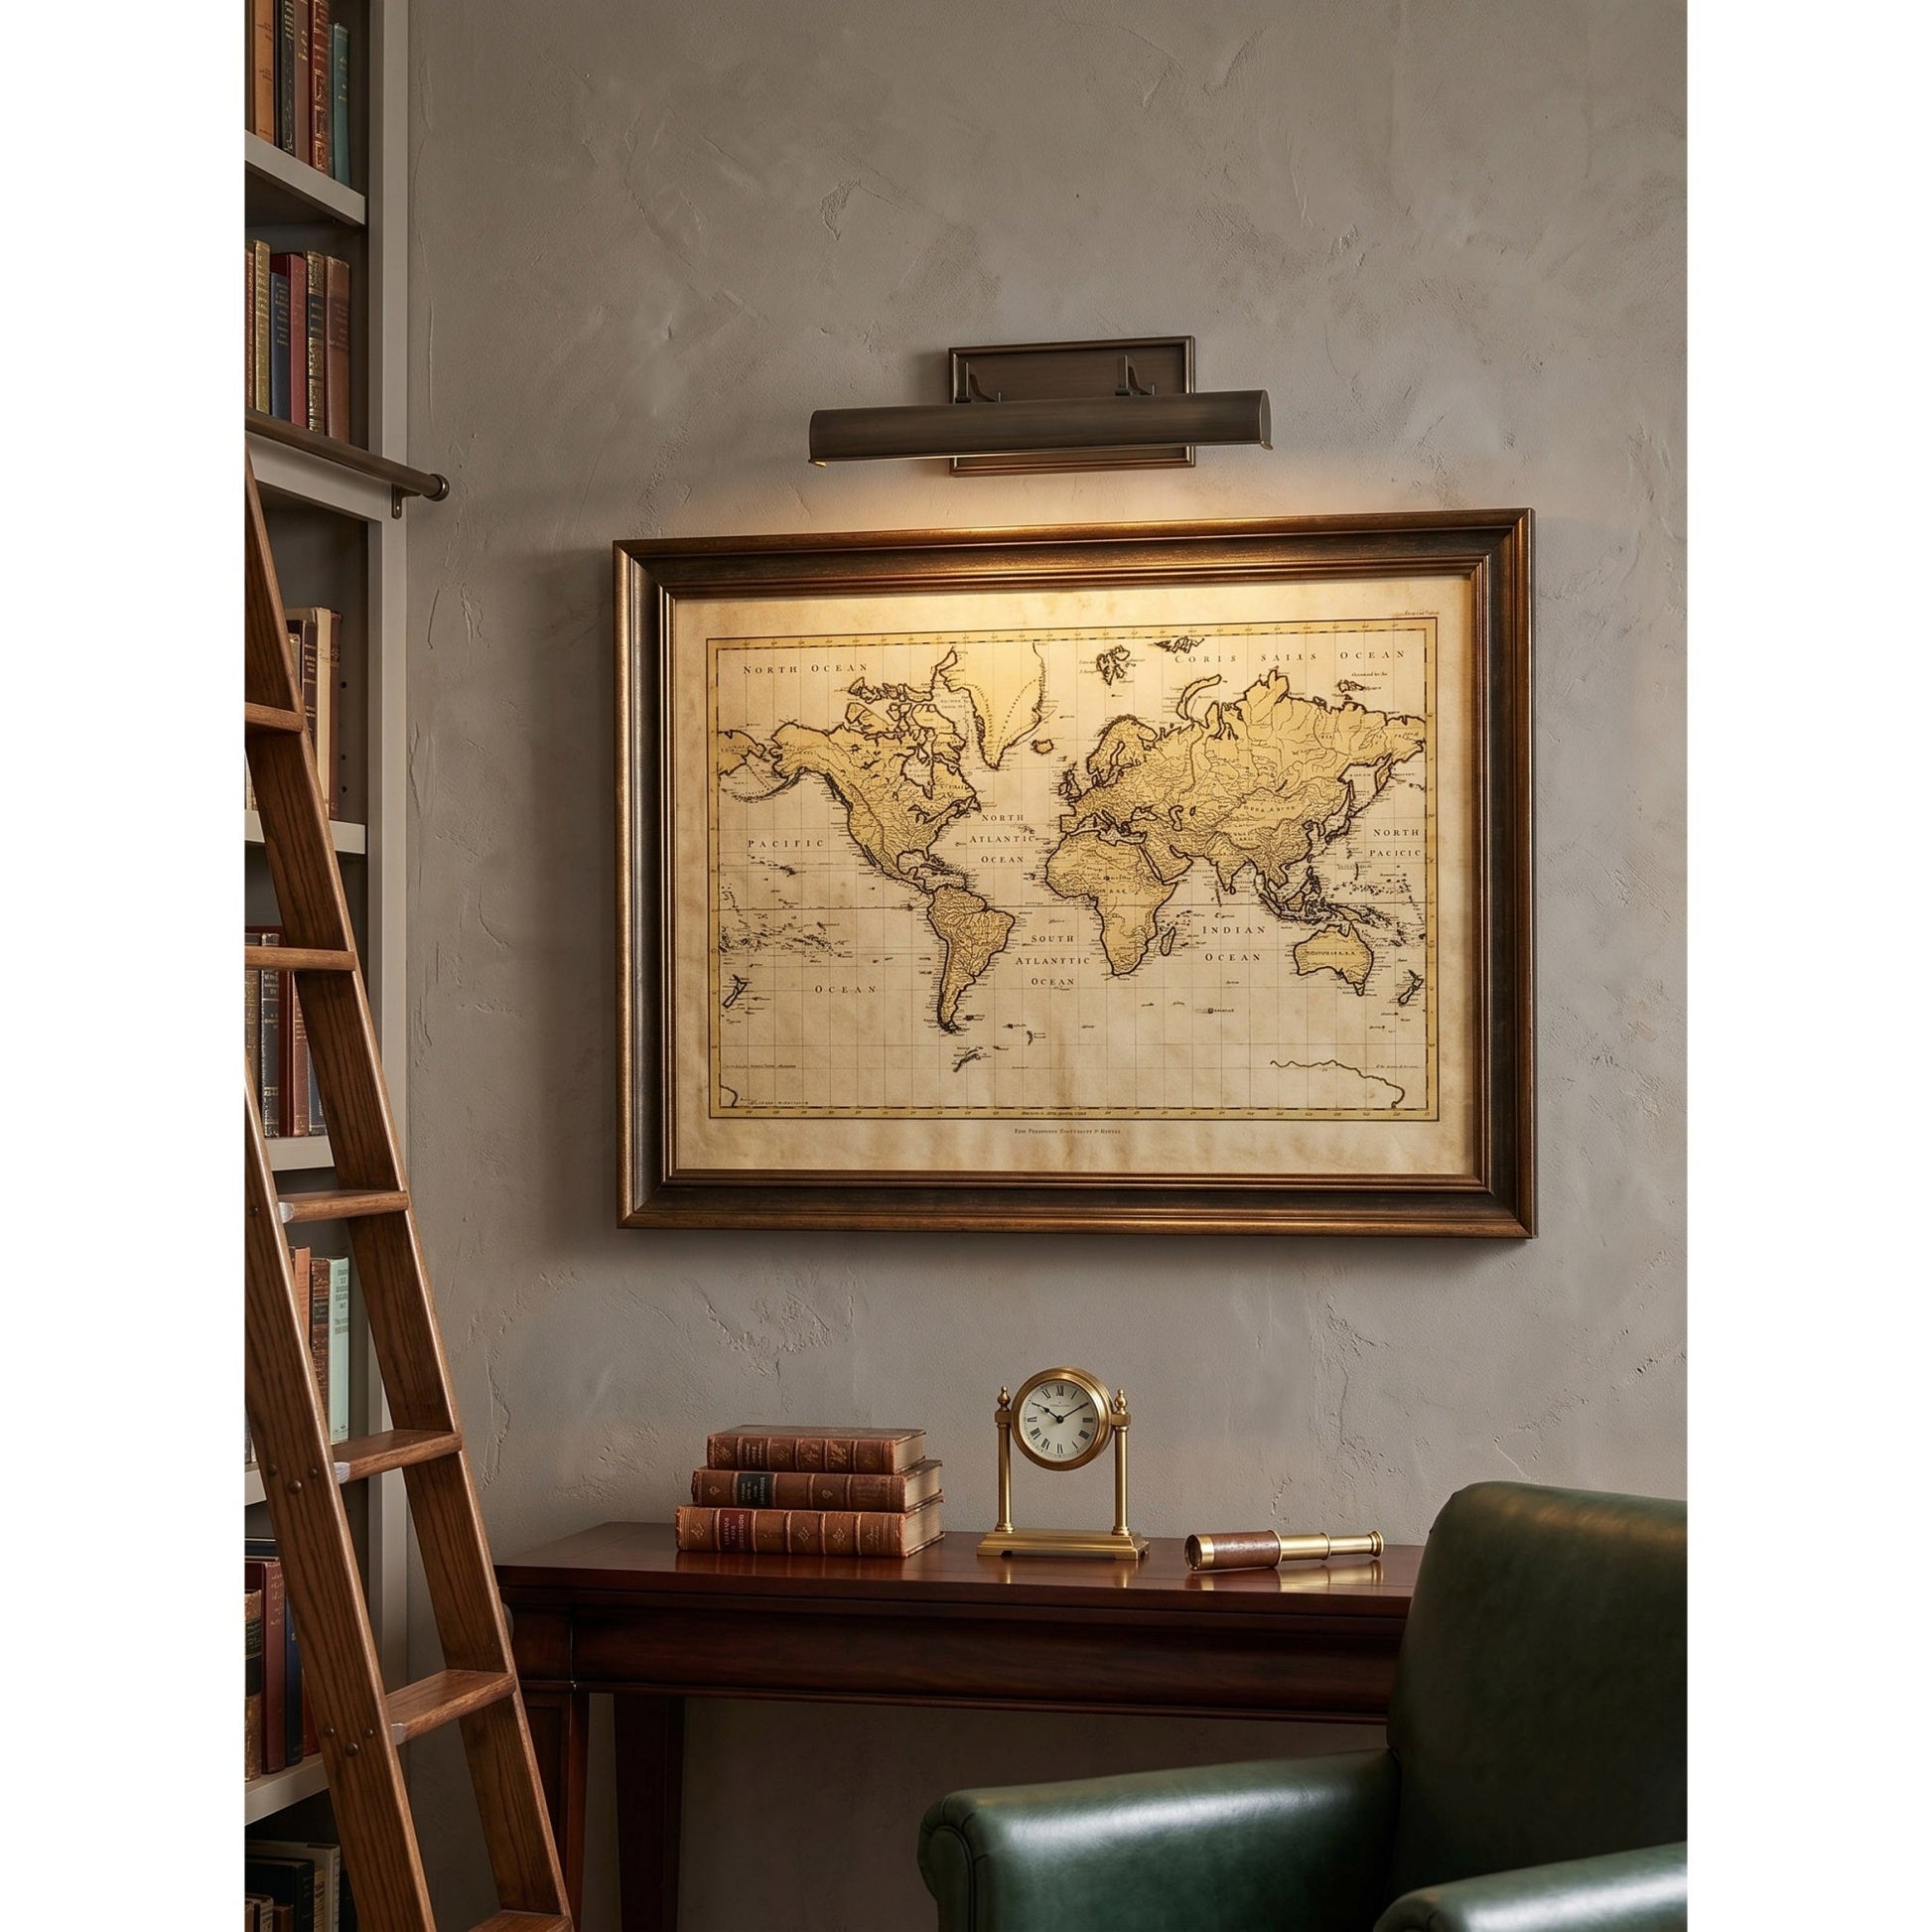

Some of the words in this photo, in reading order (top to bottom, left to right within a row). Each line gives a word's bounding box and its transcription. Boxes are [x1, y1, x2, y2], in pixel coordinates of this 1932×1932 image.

[1339, 650, 1405, 660] OCEAN
[743, 665, 797, 674] NORTH
[810, 663, 868, 673] OCEAN
[1373, 828, 1419, 837] NORTH
[980, 855, 1024, 864] OCEAN
[1202, 925, 1266, 934] INDIAN
[1031, 934, 1074, 943] SOUTH
[1204, 952, 1260, 962] OCEAN
[1031, 977, 1074, 986] OCEAN
[814, 984, 876, 994] OCEAN
